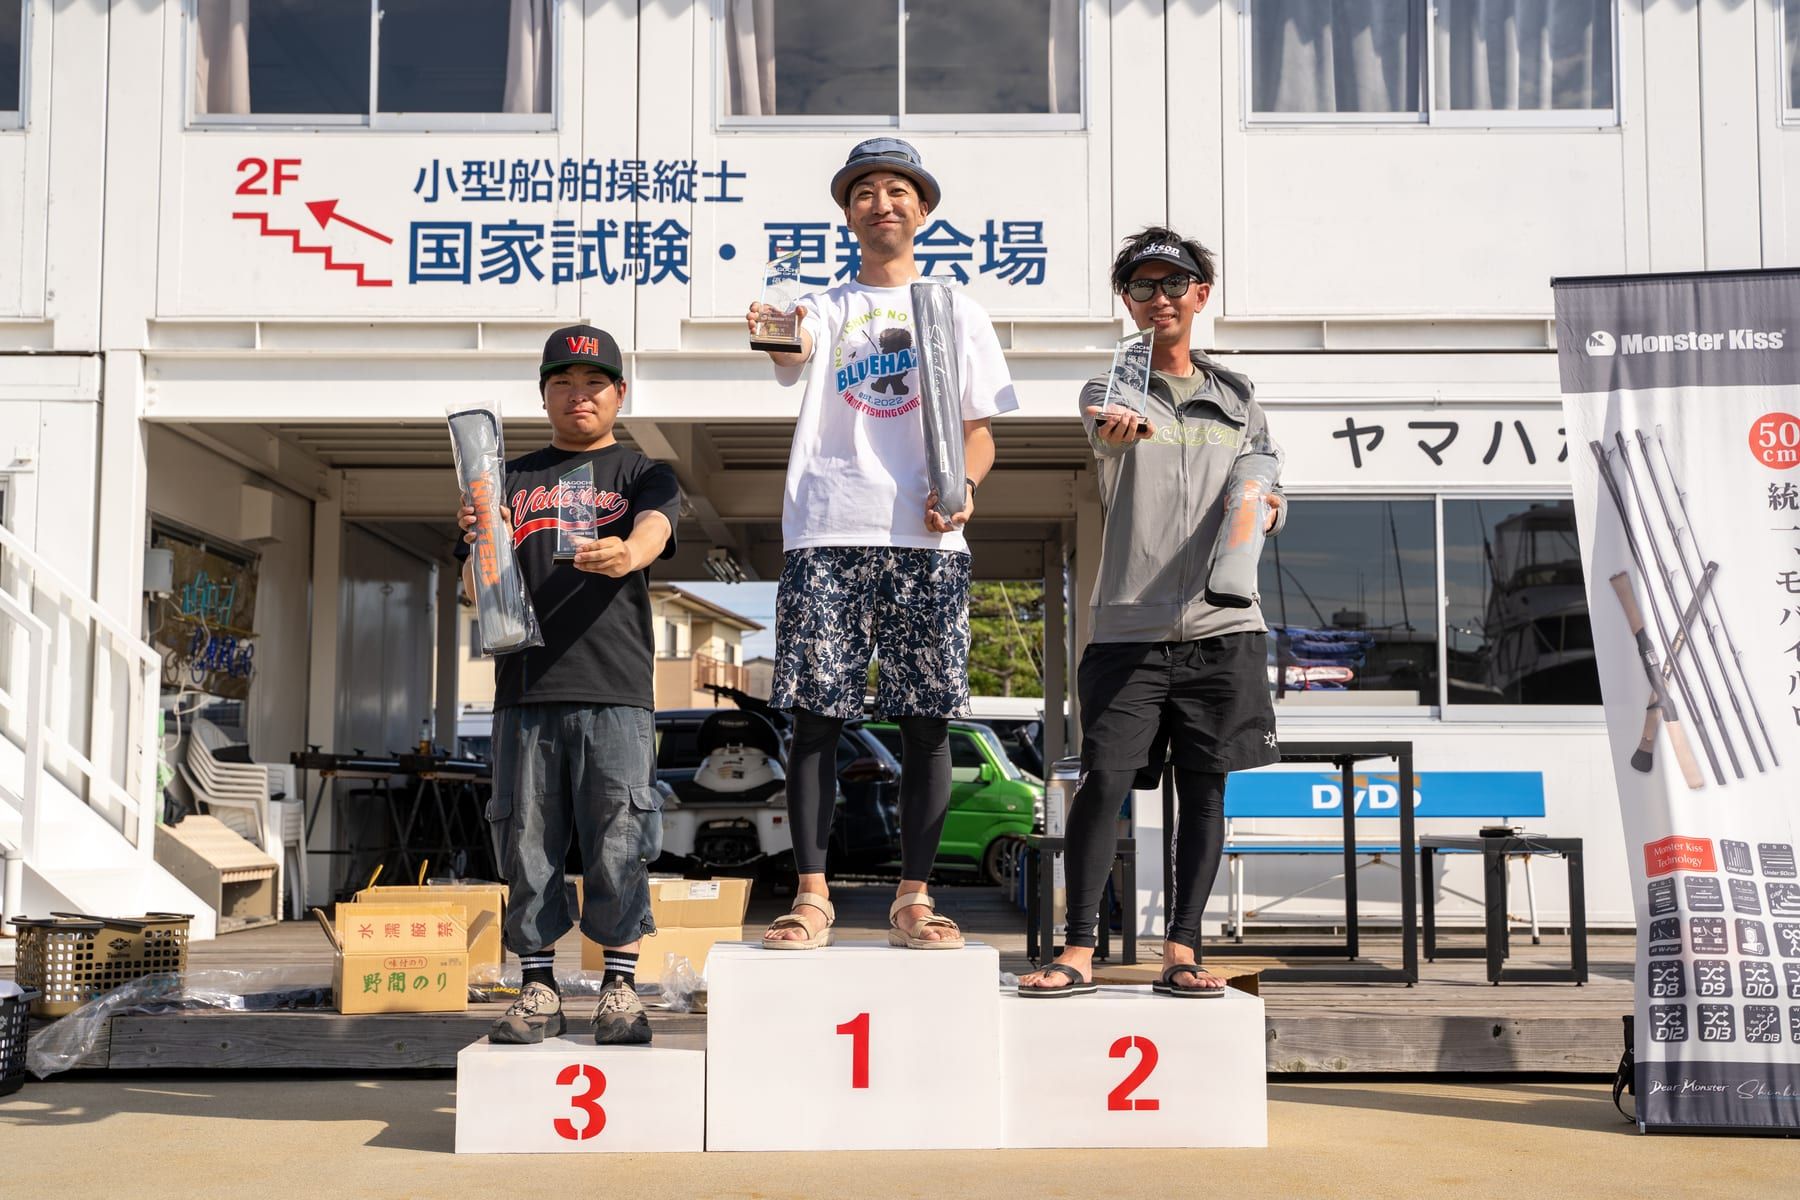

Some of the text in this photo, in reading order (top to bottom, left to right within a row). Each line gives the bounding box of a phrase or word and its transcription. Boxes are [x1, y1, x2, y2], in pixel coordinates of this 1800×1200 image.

[235, 158, 302, 195] 2F
[414, 158, 747, 204] 小型船舶操縦士
[887, 309, 907, 321] NO
[566, 335, 599, 357] VH
[1621, 329, 1784, 355] Monster Kiss
[835, 347, 918, 392] BLUEHA
[861, 404, 897, 418] FISHING
[1759, 421, 1800, 448] 50
[1763, 449, 1798, 462] cm
[1654, 841, 1703, 856] Monster Kiss
[1657, 854, 1703, 867] Technology
[388, 958, 425, 968] 味付のり
[363, 971, 447, 994] 野間のり
[1653, 982, 1680, 997] D8
[1701, 982, 1726, 996] D9
[1656, 1026, 1685, 1041] D12
[1703, 1026, 1732, 1040] D13
[836, 1012, 870, 1089] 1
[1107, 1035, 1160, 1111] 2
[1649, 1079, 1729, 1095] Dear Monster
[553, 1063, 607, 1140] 3
